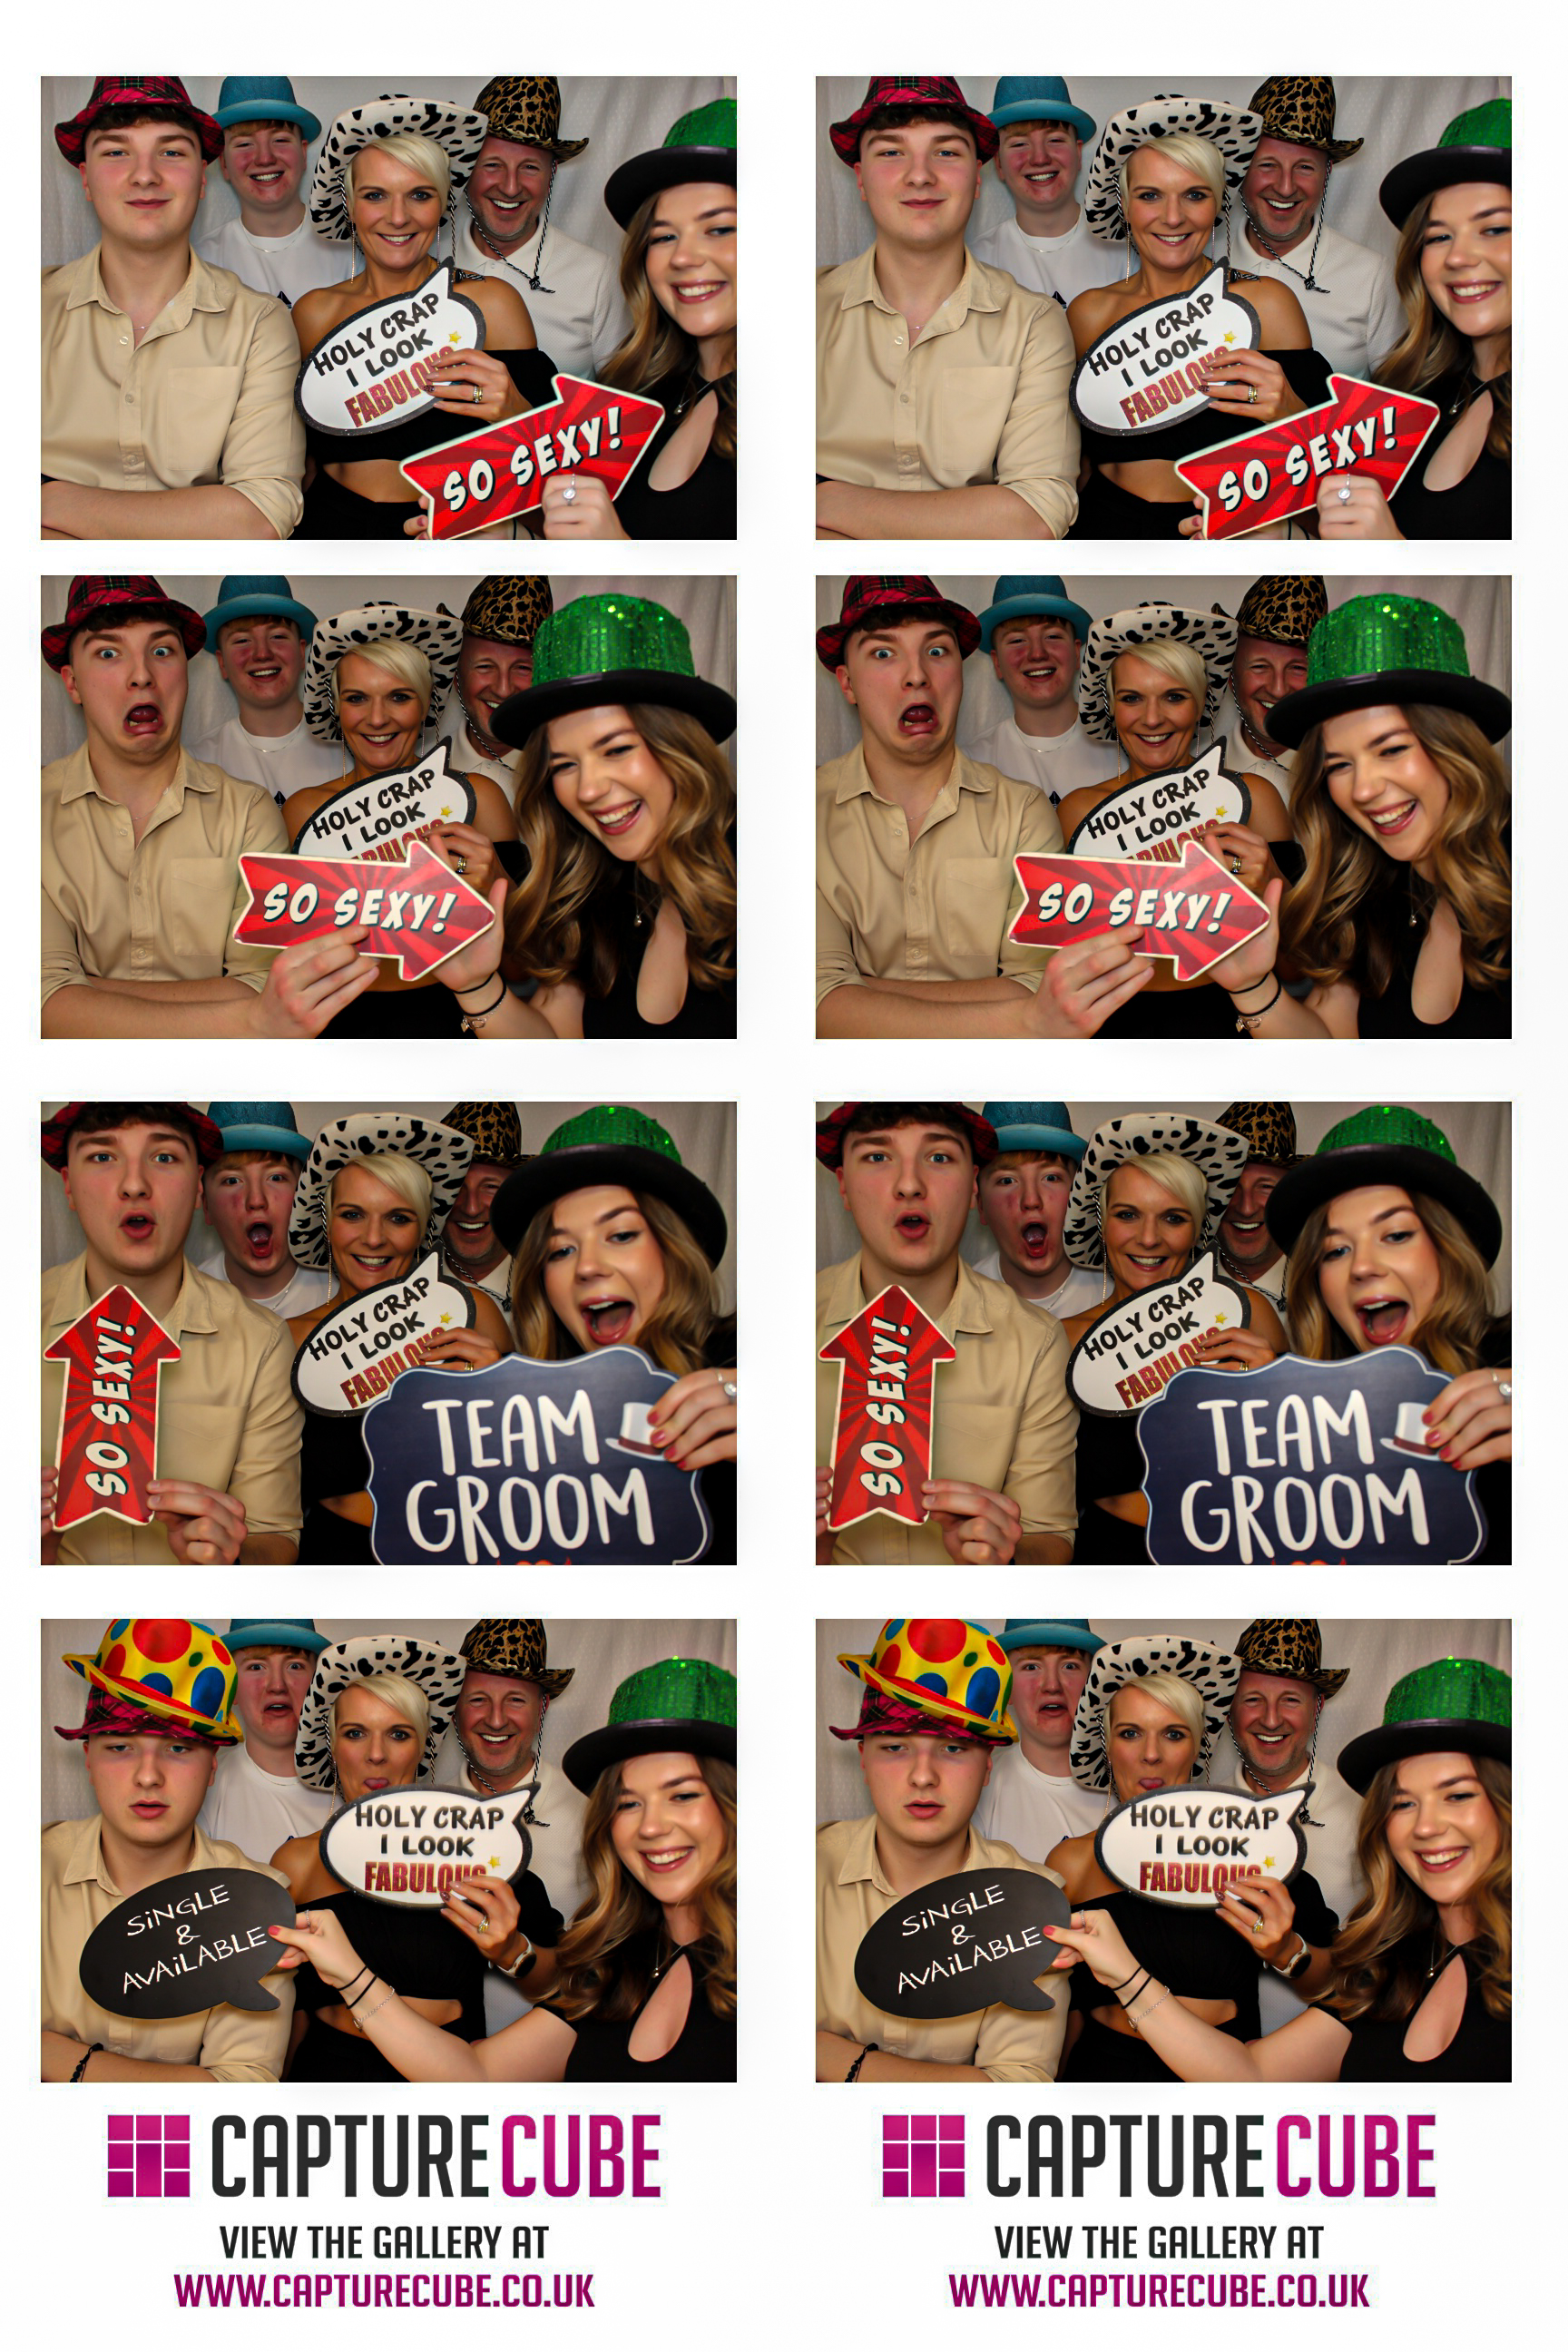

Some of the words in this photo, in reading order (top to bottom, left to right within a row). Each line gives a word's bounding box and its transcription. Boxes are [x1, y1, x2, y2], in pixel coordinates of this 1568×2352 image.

[311, 327, 376, 377] HOLY
[380, 293, 440, 338] CRAP
[346, 368, 359, 387] I
[364, 329, 434, 377] LOOK
[1086, 327, 1151, 377] HOLY
[1155, 293, 1215, 338] CRAP
[1121, 368, 1134, 387] I
[1139, 329, 1209, 377] LOOK
[443, 458, 496, 513] SO
[510, 407, 622, 486] SEXY!
[1218, 458, 1271, 513] SO
[1285, 407, 1397, 486] SEXY!
[310, 797, 372, 839] HOLY
[377, 769, 436, 808] CRAP
[341, 833, 353, 851] I
[359, 801, 426, 844] LOOK
[1085, 797, 1147, 839] HOLY
[1152, 769, 1210, 808] CRAP
[1116, 833, 1128, 851] I
[1134, 801, 1201, 844] LOOK
[263, 882, 319, 924] SO
[333, 887, 458, 935] SEXY!
[1038, 882, 1094, 924] SO
[1108, 887, 1233, 935] SEXY!
[308, 1311, 368, 1361] HOLY
[373, 1277, 430, 1322] CRAP
[340, 1352, 354, 1370] I
[358, 1311, 425, 1359] LOOK
[1083, 1311, 1143, 1361] HOLY
[1148, 1277, 1205, 1322] CRAP
[1115, 1352, 1129, 1370] I
[1133, 1311, 1200, 1359] LOOK
[92, 1315, 138, 1426] SEXY!
[867, 1315, 913, 1426] SEXY!
[421, 1388, 600, 1475] TEAM
[1196, 1388, 1375, 1475] TEAM
[84, 1440, 132, 1497] SO
[859, 1440, 906, 1497] SO
[406, 1467, 655, 1565] GROOM
[1181, 1467, 1430, 1565] GROOM
[355, 1804, 427, 1828] HOLY
[434, 1806, 505, 1830] CRAP
[380, 1833, 387, 1854] I
[402, 1835, 475, 1857] LOOK
[1130, 1804, 1202, 1828] HOLY
[1209, 1806, 1279, 1830] CRAP
[1155, 1833, 1162, 1854] I
[1177, 1835, 1250, 1857] LOOK
[176, 1925, 201, 1945] &
[951, 1925, 976, 1945] &
